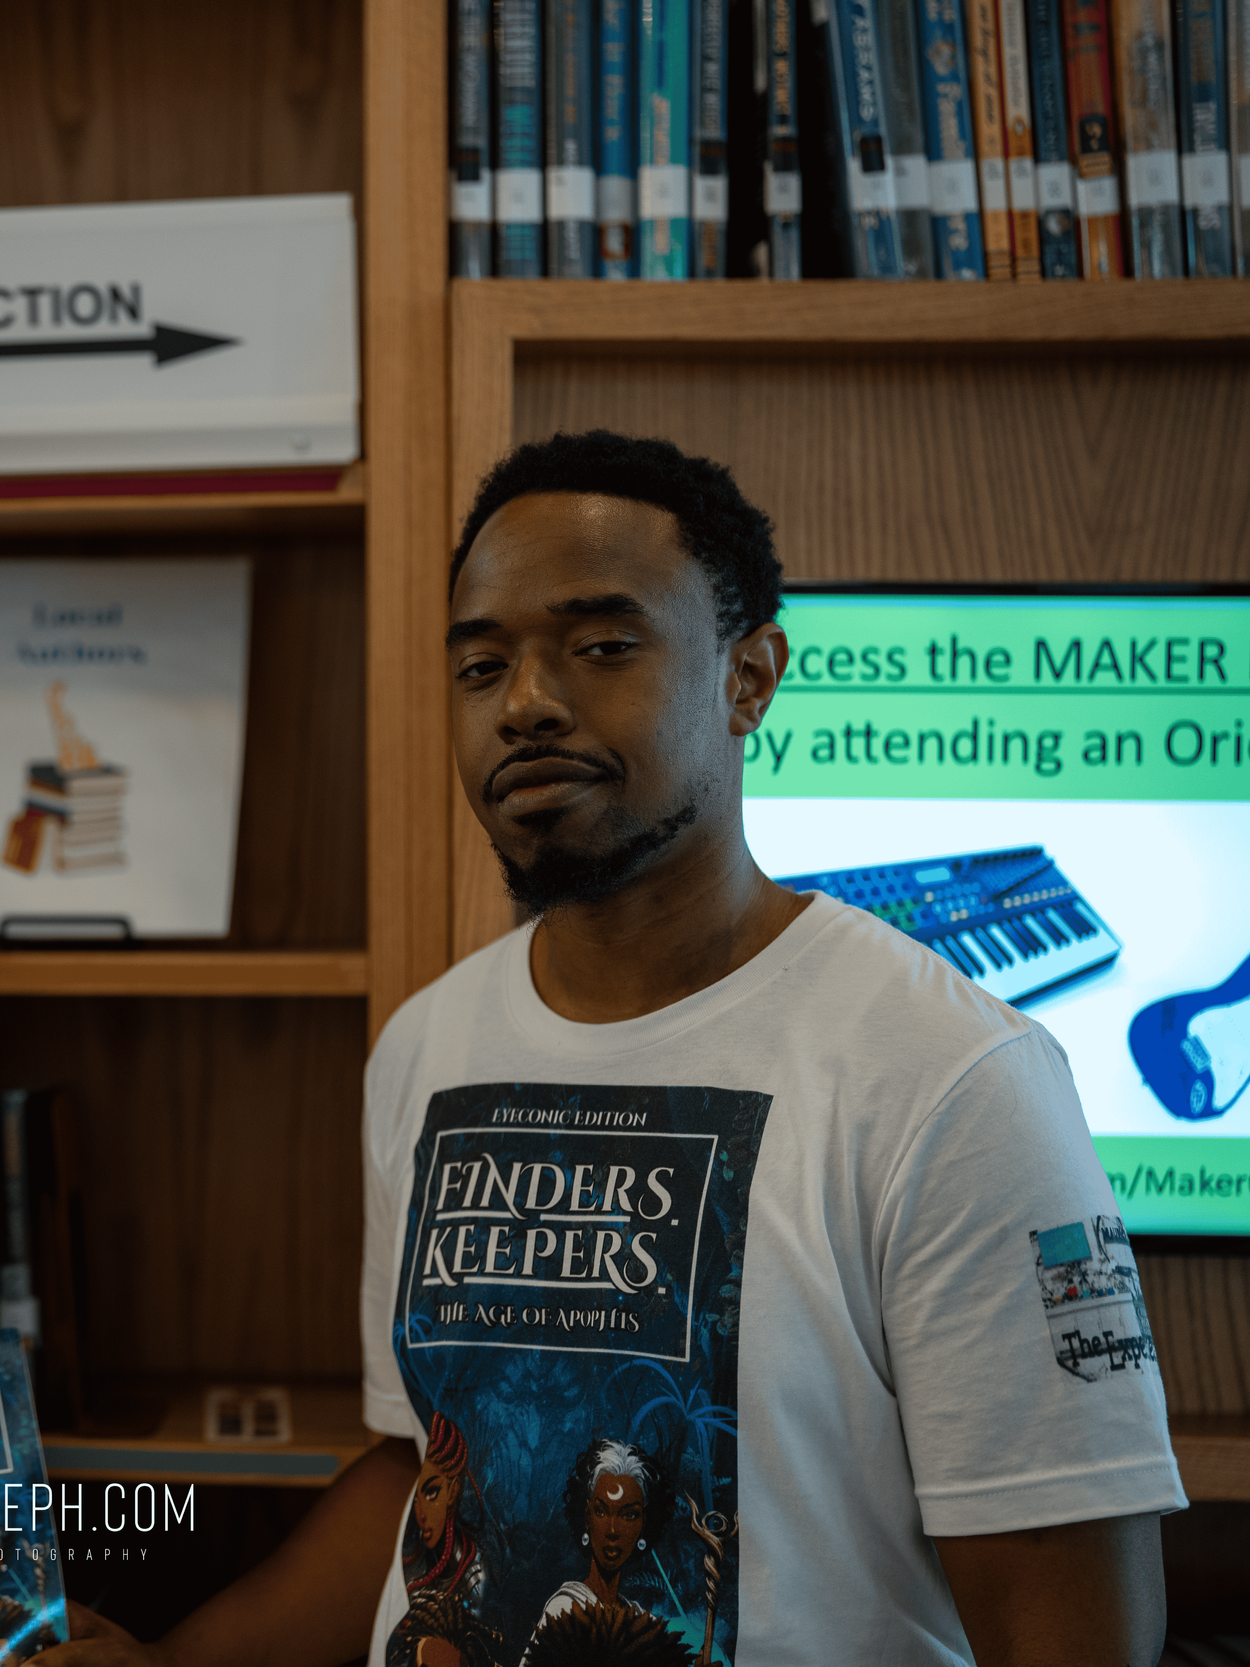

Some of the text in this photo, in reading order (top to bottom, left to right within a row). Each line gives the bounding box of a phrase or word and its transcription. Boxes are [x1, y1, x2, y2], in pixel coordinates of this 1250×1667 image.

[924, 632, 1012, 682] the
[1034, 636, 1228, 683] MAKER
[810, 714, 1063, 778] attending
[1082, 729, 1143, 766] an
[1164, 718, 1250, 767] Ori
[491, 1107, 647, 1127] EYECONIC EDITION
[435, 1152, 680, 1227] FINDERS.
[421, 1223, 668, 1295] KEEPERS.
[437, 1300, 468, 1326] THE
[475, 1303, 518, 1328] AGE
[521, 1305, 552, 1326] OF
[1061, 1329, 1102, 1368] The
